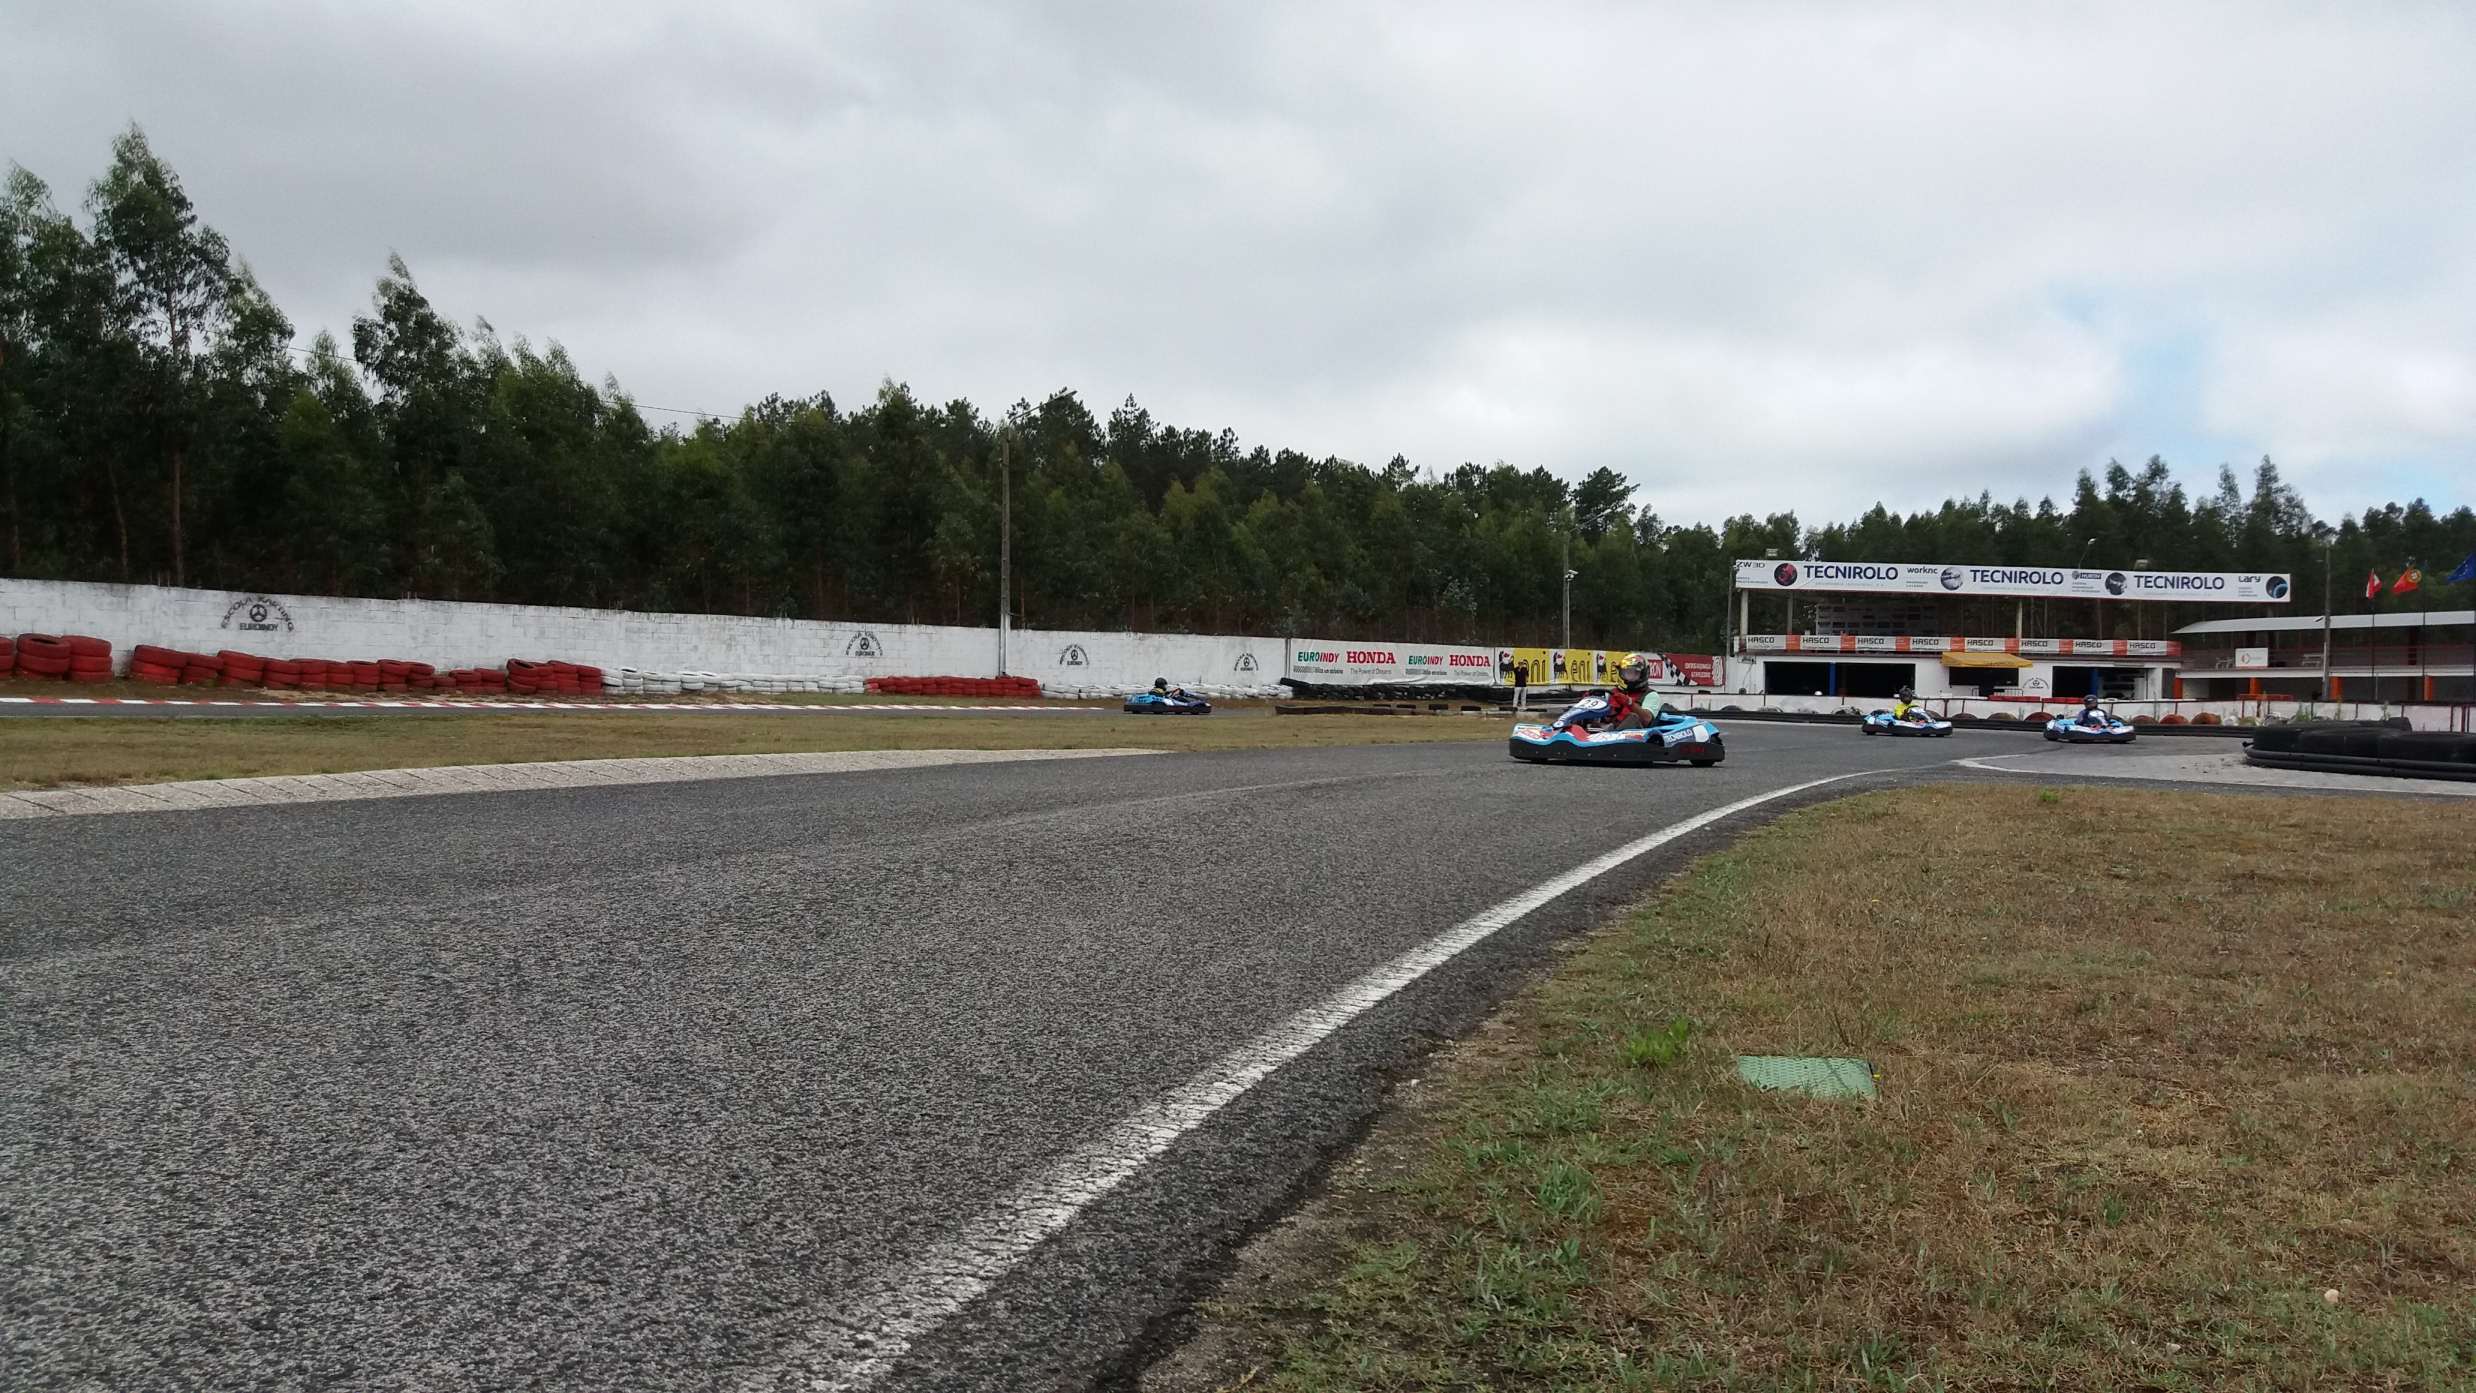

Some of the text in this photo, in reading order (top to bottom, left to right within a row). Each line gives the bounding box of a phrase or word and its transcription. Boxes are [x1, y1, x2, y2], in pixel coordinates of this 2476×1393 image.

[1803, 565, 1899, 580] TECNIROLO
[1970, 569, 2064, 585] TECNIROLO
[2134, 575, 2225, 590] TECNIROLO
[1747, 636, 1775, 644] HASCO
[1967, 639, 1994, 647] HASCO
[2075, 641, 2102, 649] HASCO
[1297, 651, 1396, 665] EUROINDY HONDA
[1408, 655, 1491, 667] EUROINDY HONDA
